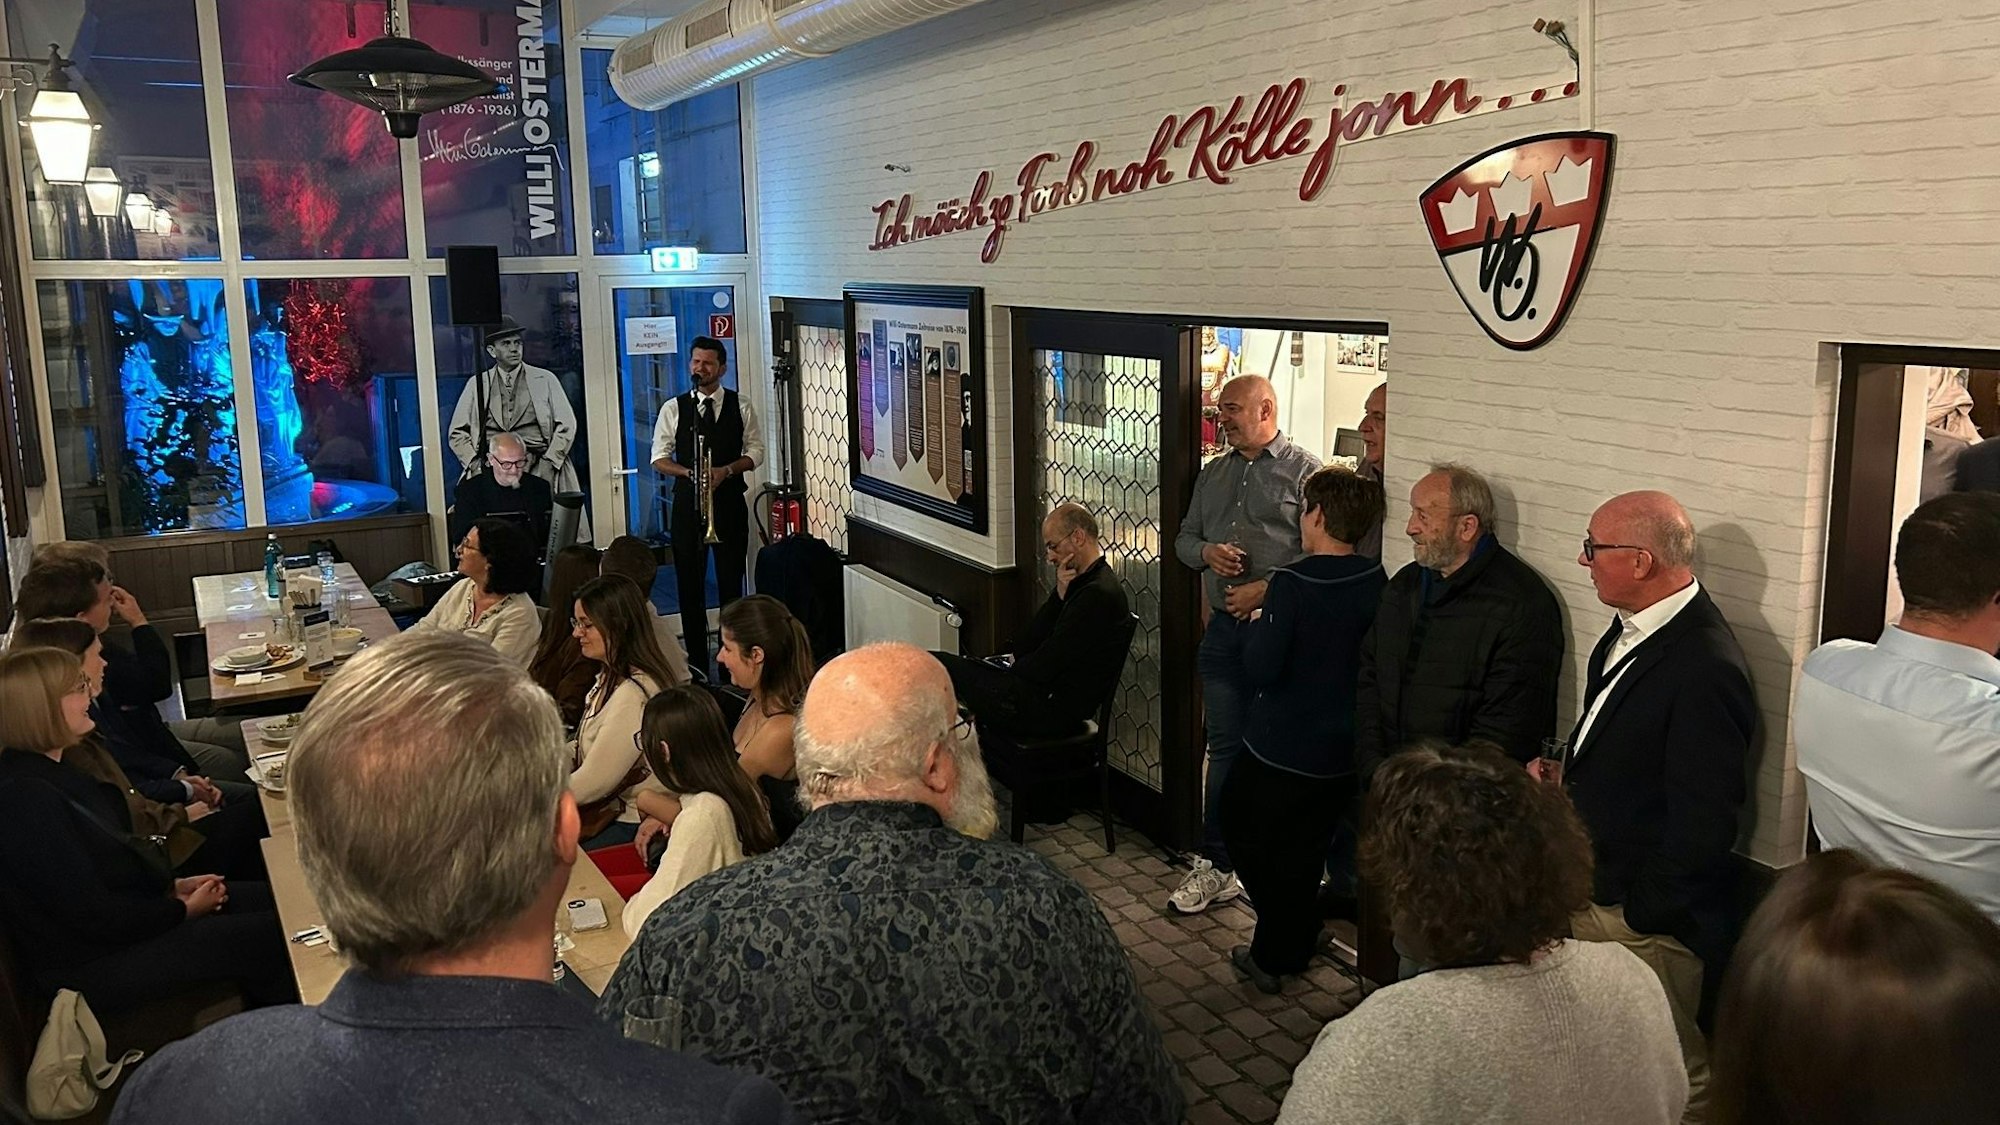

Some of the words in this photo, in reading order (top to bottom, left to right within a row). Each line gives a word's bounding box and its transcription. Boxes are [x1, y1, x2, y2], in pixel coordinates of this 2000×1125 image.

[523, 154, 556, 240] WILLI
[868, 193, 912, 251] Ich
[981, 193, 1015, 264] zo
[1091, 115, 1179, 202] noh
[1173, 77, 1312, 186] Kölle
[1300, 77, 1482, 201] jonn
